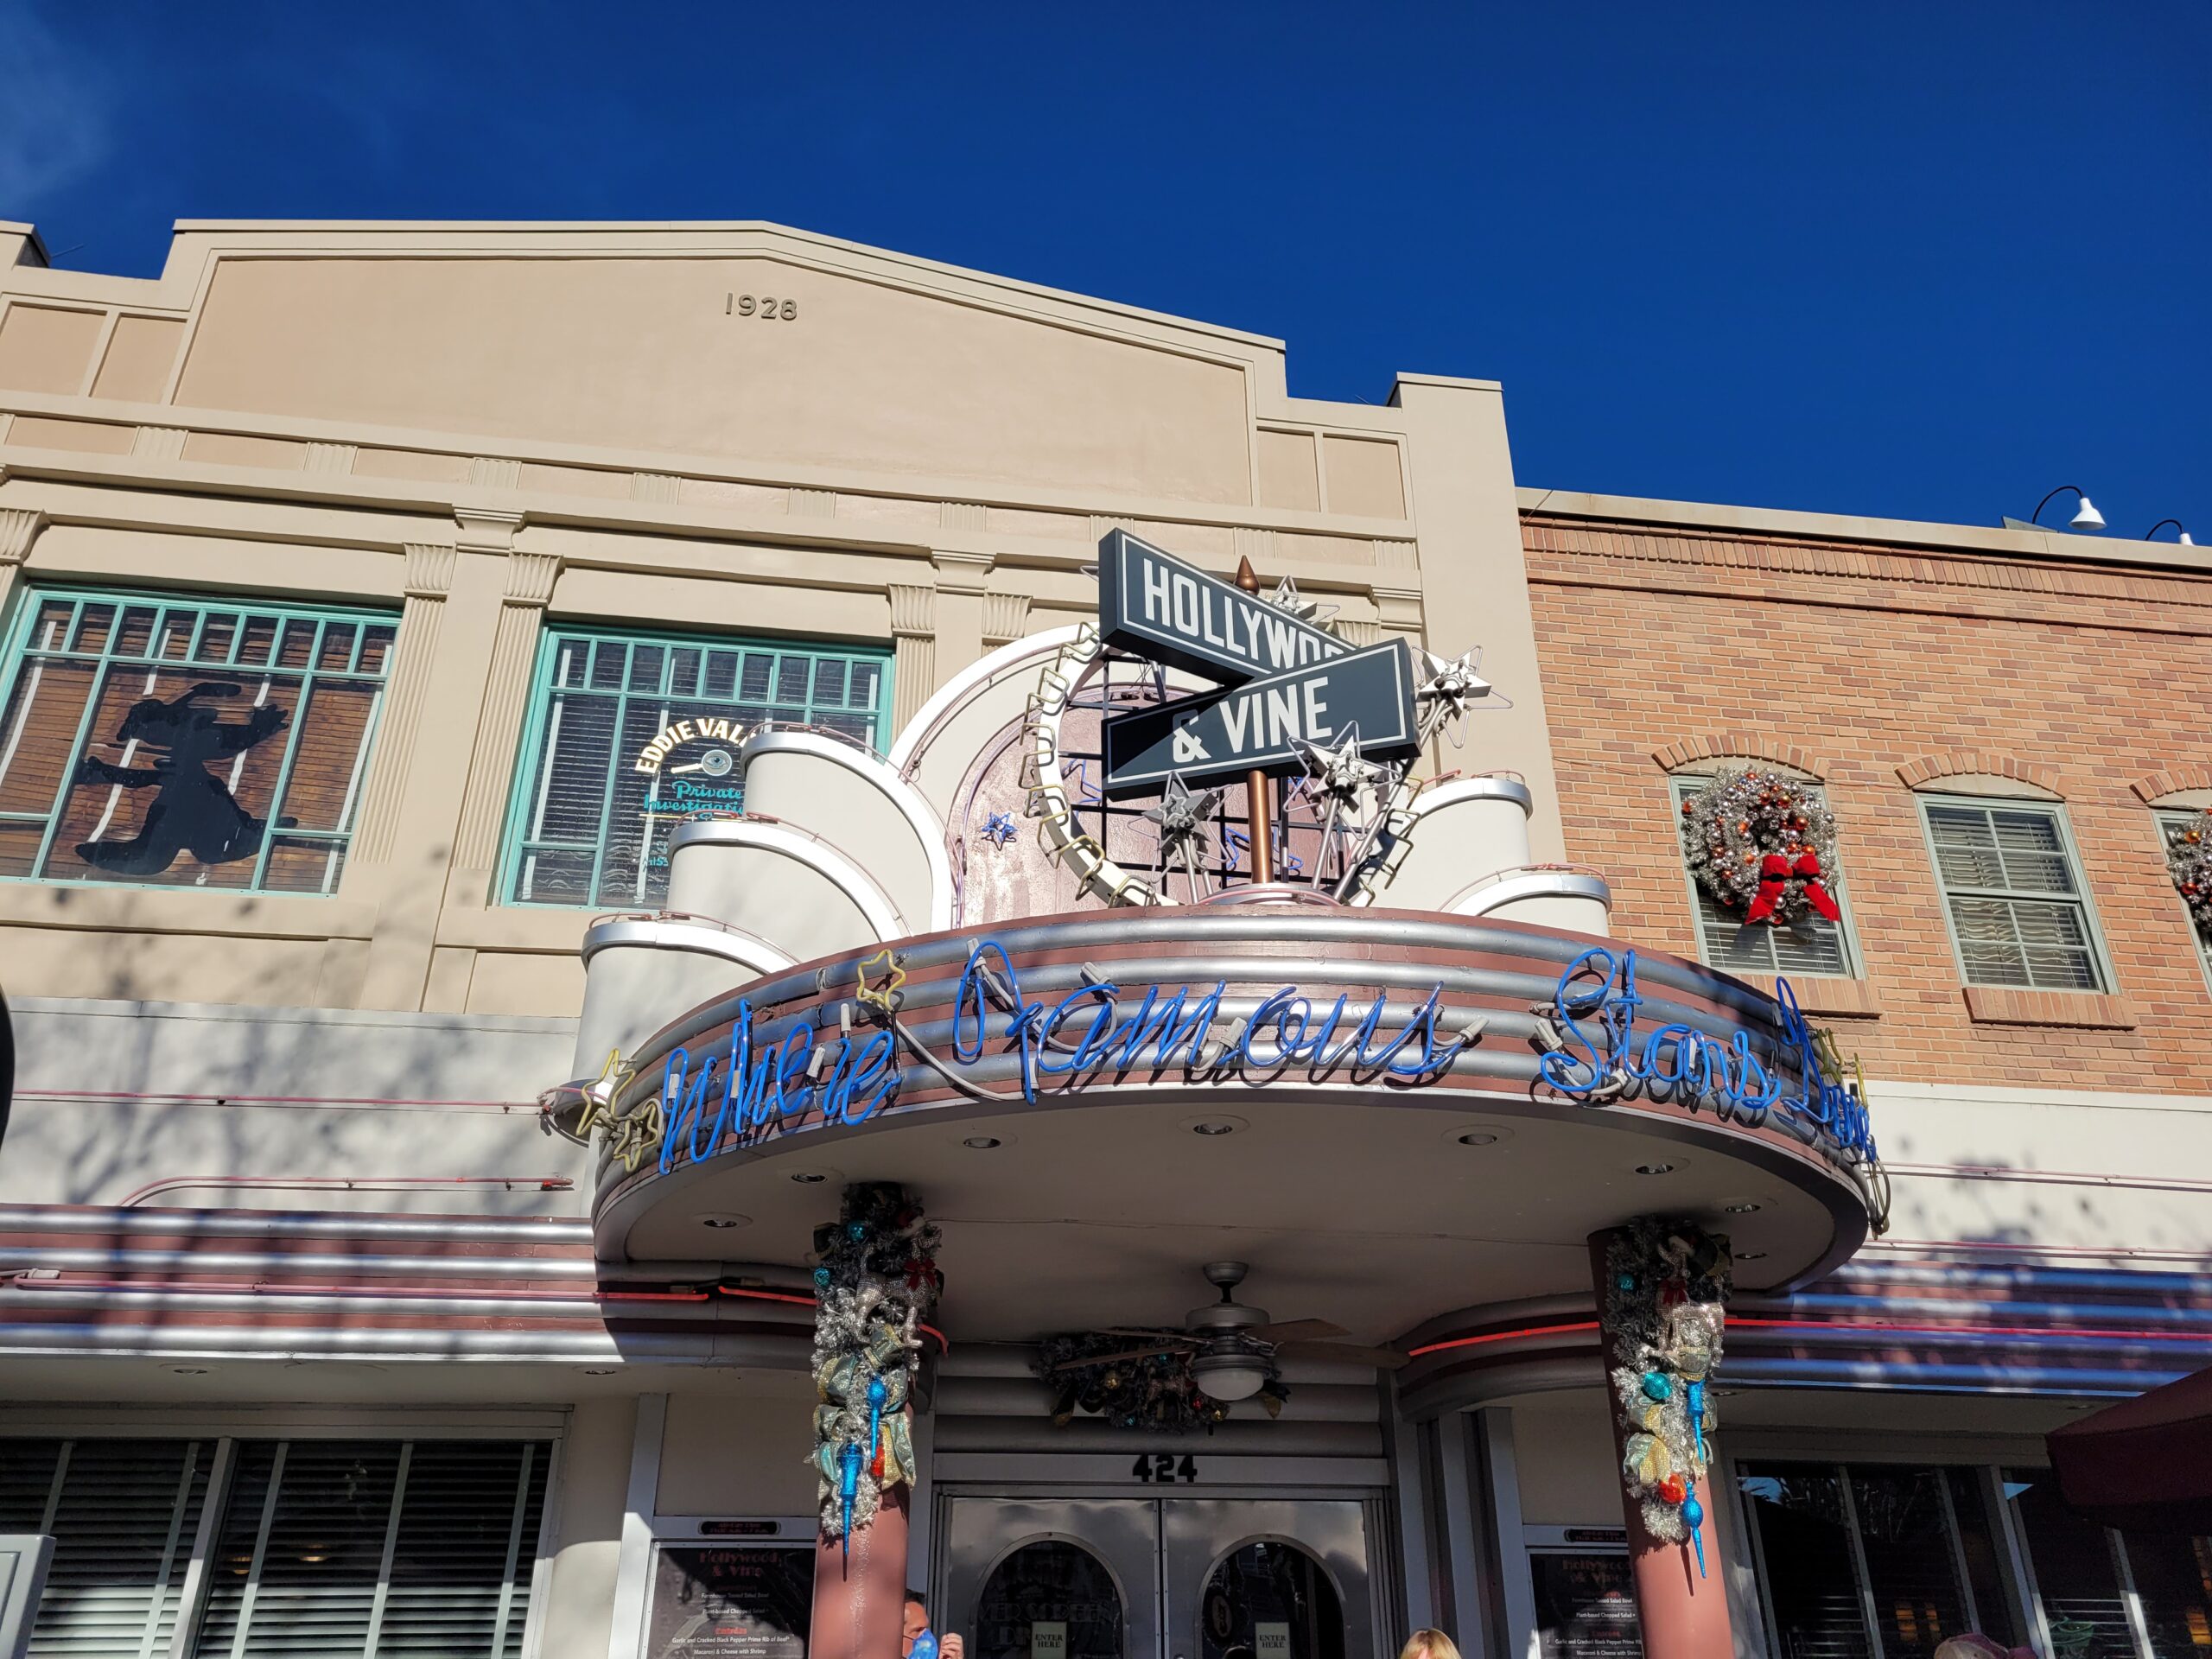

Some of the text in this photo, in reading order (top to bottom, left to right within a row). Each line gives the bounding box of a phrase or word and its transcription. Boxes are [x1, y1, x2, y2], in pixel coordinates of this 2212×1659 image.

[726, 293, 797, 321] 1928
[1144, 558, 1344, 670] HOLLYWO
[1173, 677, 1332, 763] & VINE
[635, 721, 695, 773] EDDIE
[672, 780, 743, 799] Private
[953, 939, 1468, 1106] Famous
[1539, 946, 1782, 1109] Stars
[1132, 1454, 1198, 1483] 424
[730, 1636, 747, 1644] Pepper
[1035, 1633, 1064, 1642] ENTER
